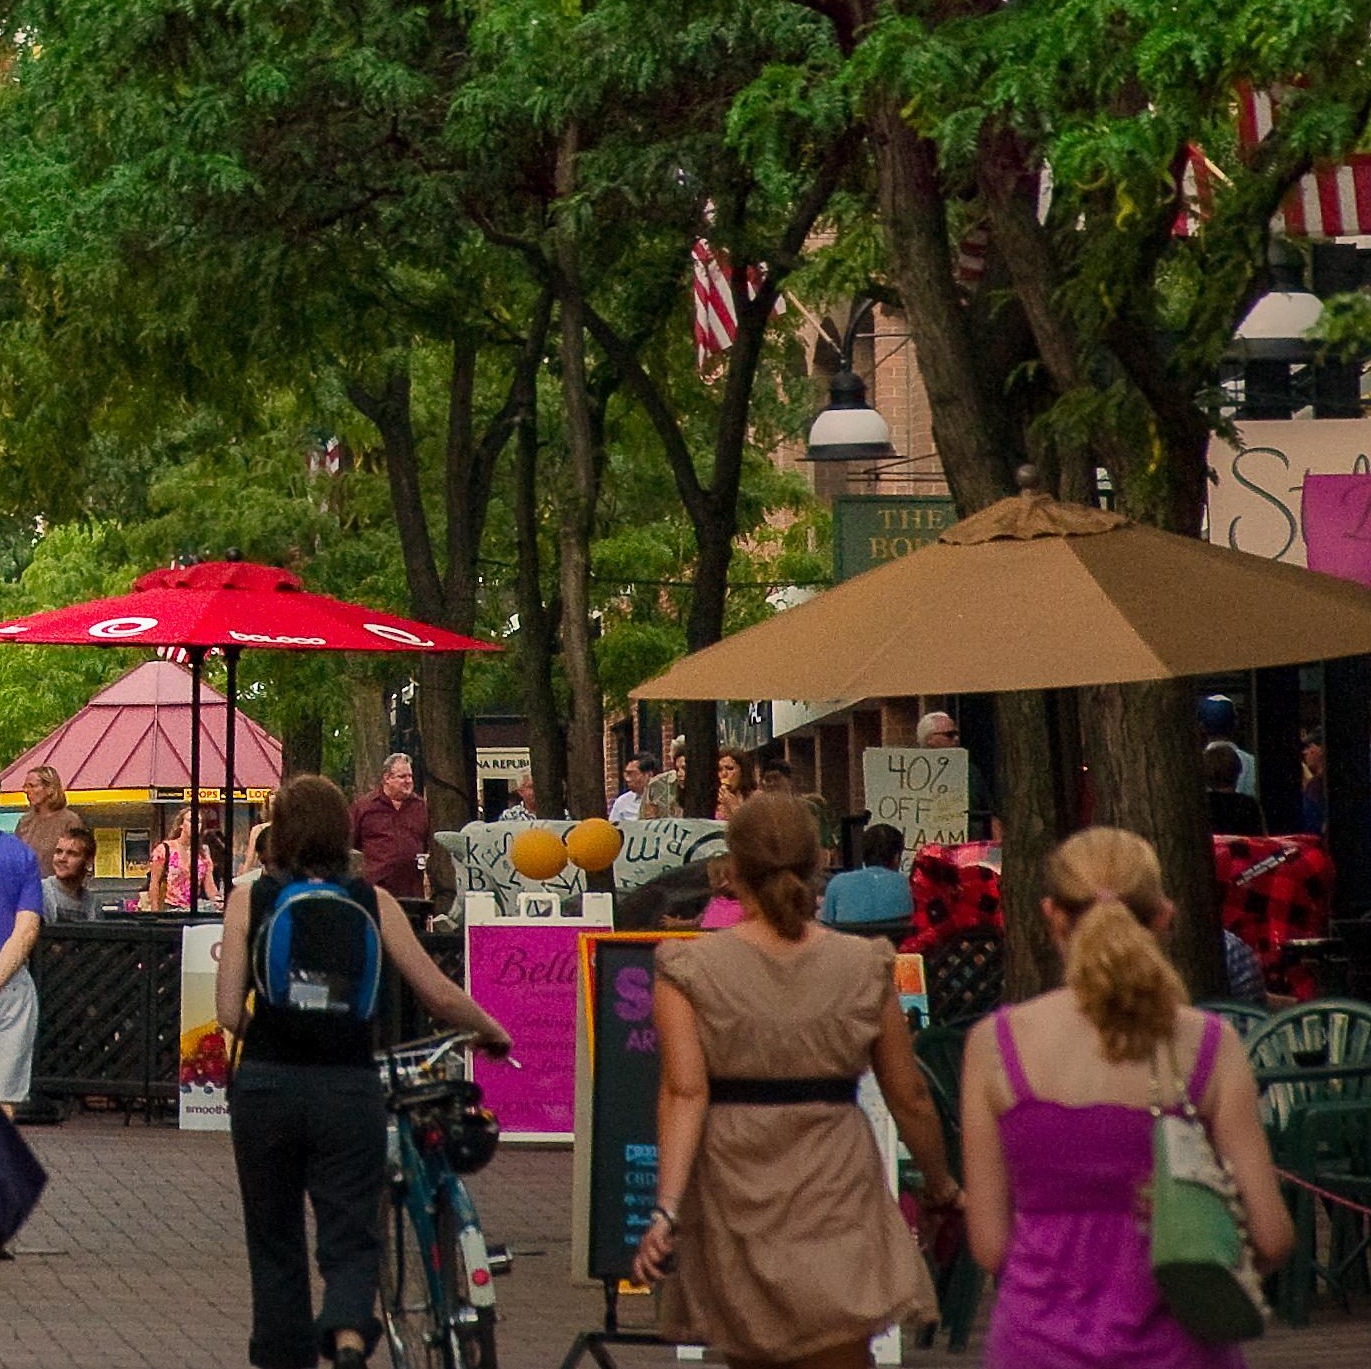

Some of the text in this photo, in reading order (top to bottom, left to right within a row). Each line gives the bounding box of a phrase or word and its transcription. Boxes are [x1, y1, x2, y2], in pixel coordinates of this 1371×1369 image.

[877, 509, 945, 529] THE
[888, 755, 950, 794] 40%
[186, 790, 219, 799] SOPS
[878, 795, 934, 823] OFF
